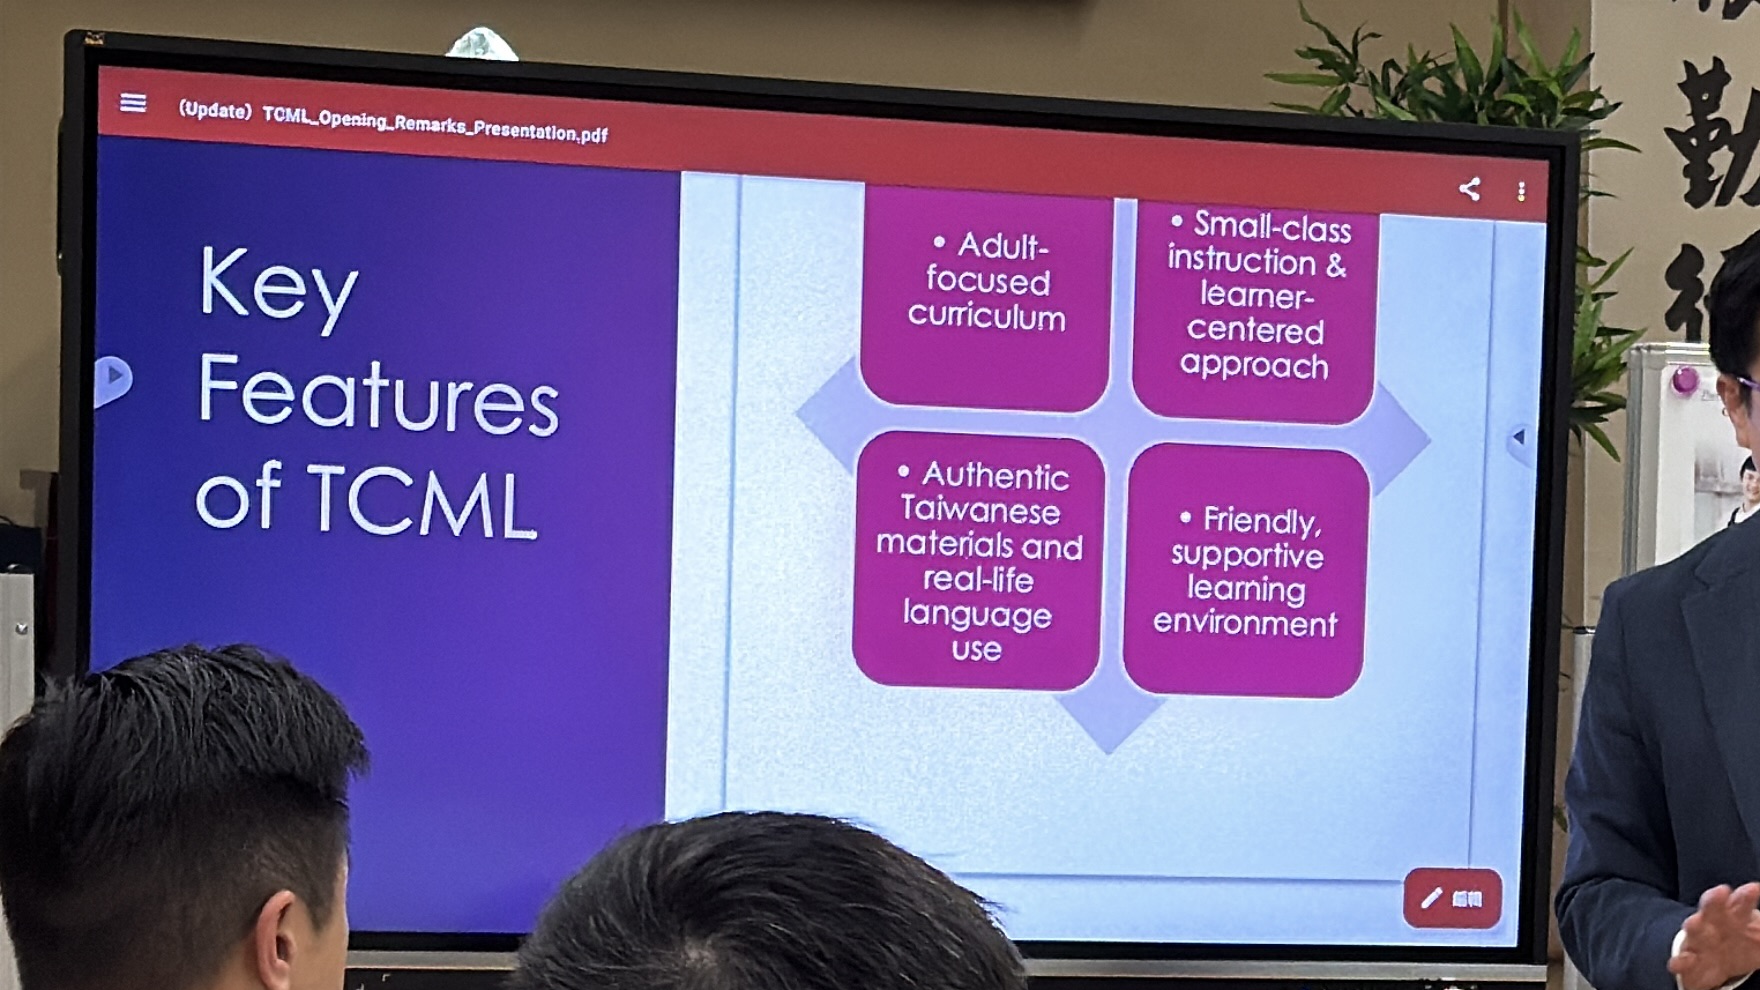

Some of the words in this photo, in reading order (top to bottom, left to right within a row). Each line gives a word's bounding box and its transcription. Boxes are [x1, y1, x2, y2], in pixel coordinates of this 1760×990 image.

[263, 106, 608, 145] TCML_Opening_Remarks_Presentation.pdf
[1195, 209, 1352, 244] Small-class
[957, 231, 1049, 261] Adult-
[1168, 242, 1316, 276] instruction
[1326, 252, 1347, 278] &
[202, 245, 359, 337] Key
[926, 263, 1051, 297] focused
[1201, 278, 1315, 310] learner-
[908, 300, 1066, 332] curriculum
[1186, 316, 1325, 346] centered
[1180, 353, 1329, 381] approach
[201, 352, 559, 437] Features
[921, 460, 1070, 492] Authentic
[196, 460, 283, 529] of
[306, 463, 538, 540] TCML
[900, 493, 1061, 526] Taiwanese
[1204, 505, 1322, 541] Friendly,
[876, 529, 1014, 559] materials
[1021, 534, 1083, 561] and
[1171, 542, 1325, 572] supportive
[924, 565, 1034, 594] real-life
[1187, 573, 1306, 608] learning
[903, 597, 1053, 631] language
[1153, 607, 1339, 638] environment
[952, 640, 1003, 662] use
